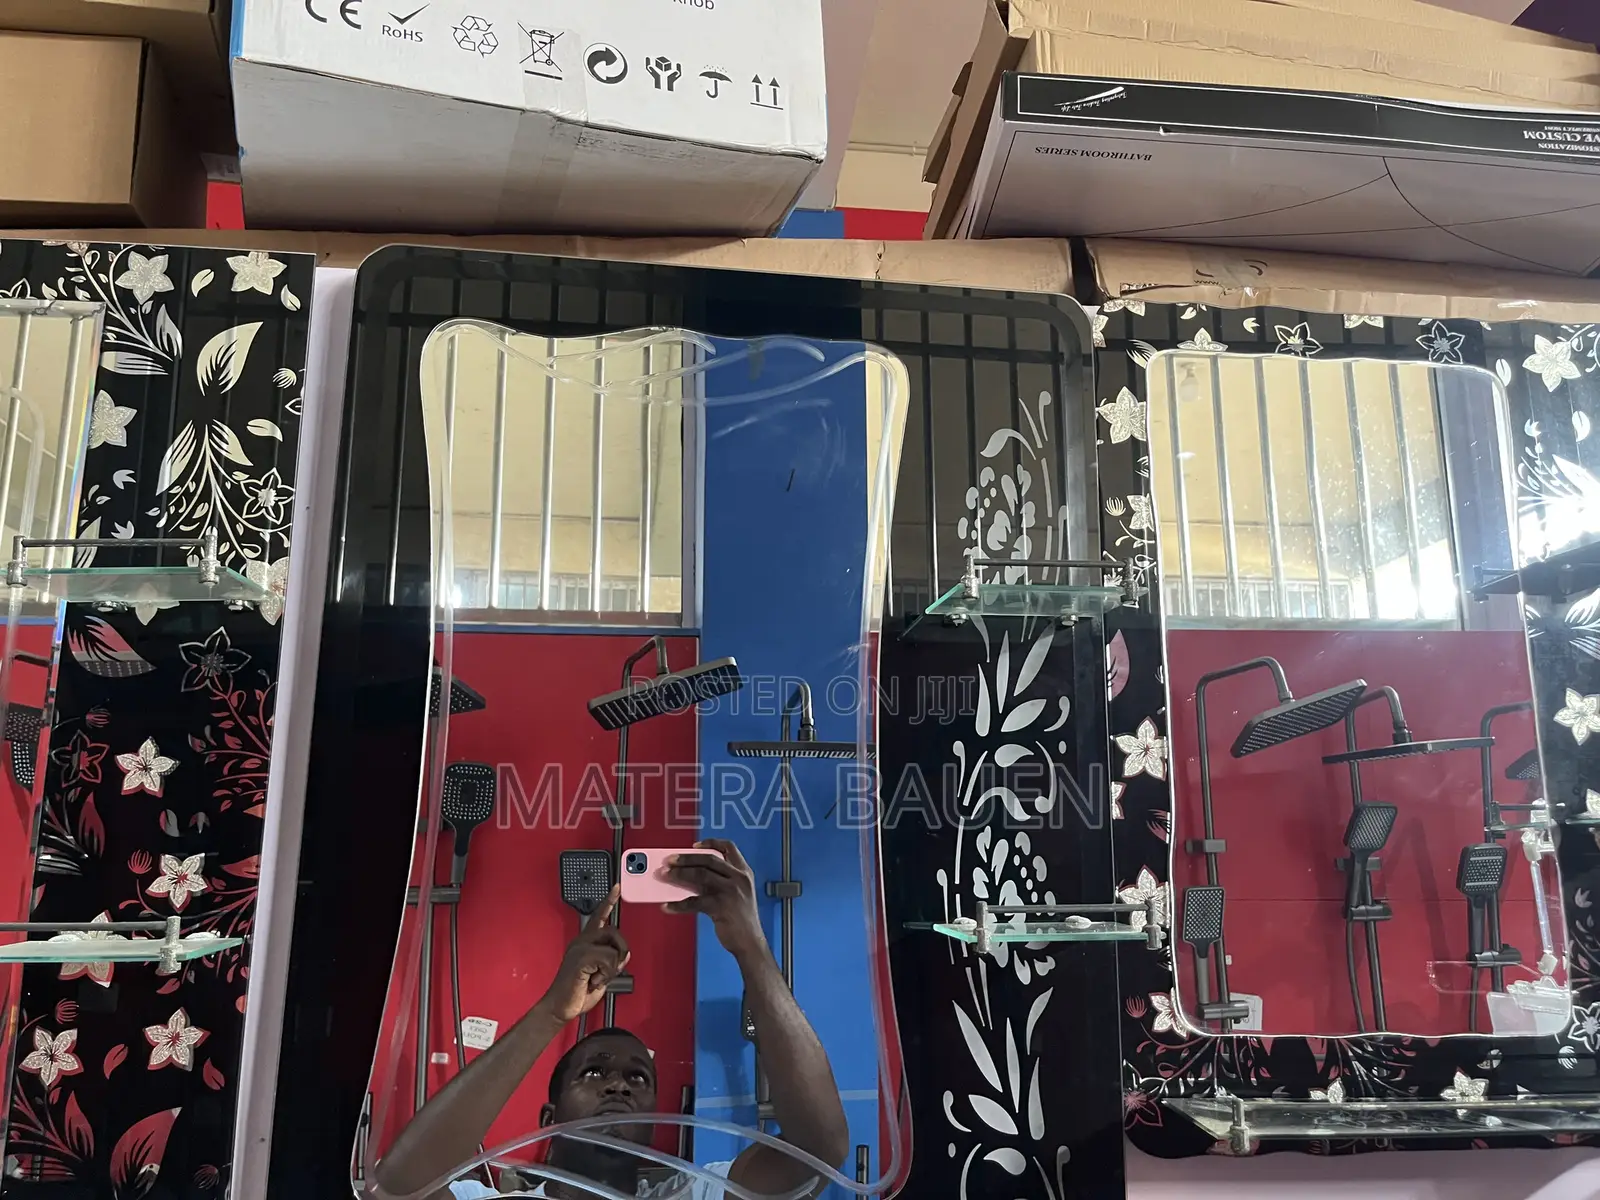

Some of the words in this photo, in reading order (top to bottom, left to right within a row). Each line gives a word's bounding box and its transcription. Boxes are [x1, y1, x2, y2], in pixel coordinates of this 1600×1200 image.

[382, 24, 423, 42] RoHS
[1523, 130, 1581, 141] CUSTOM
[1034, 146, 1079, 156] SERIES
[1080, 149, 1152, 161] BATHROOM
